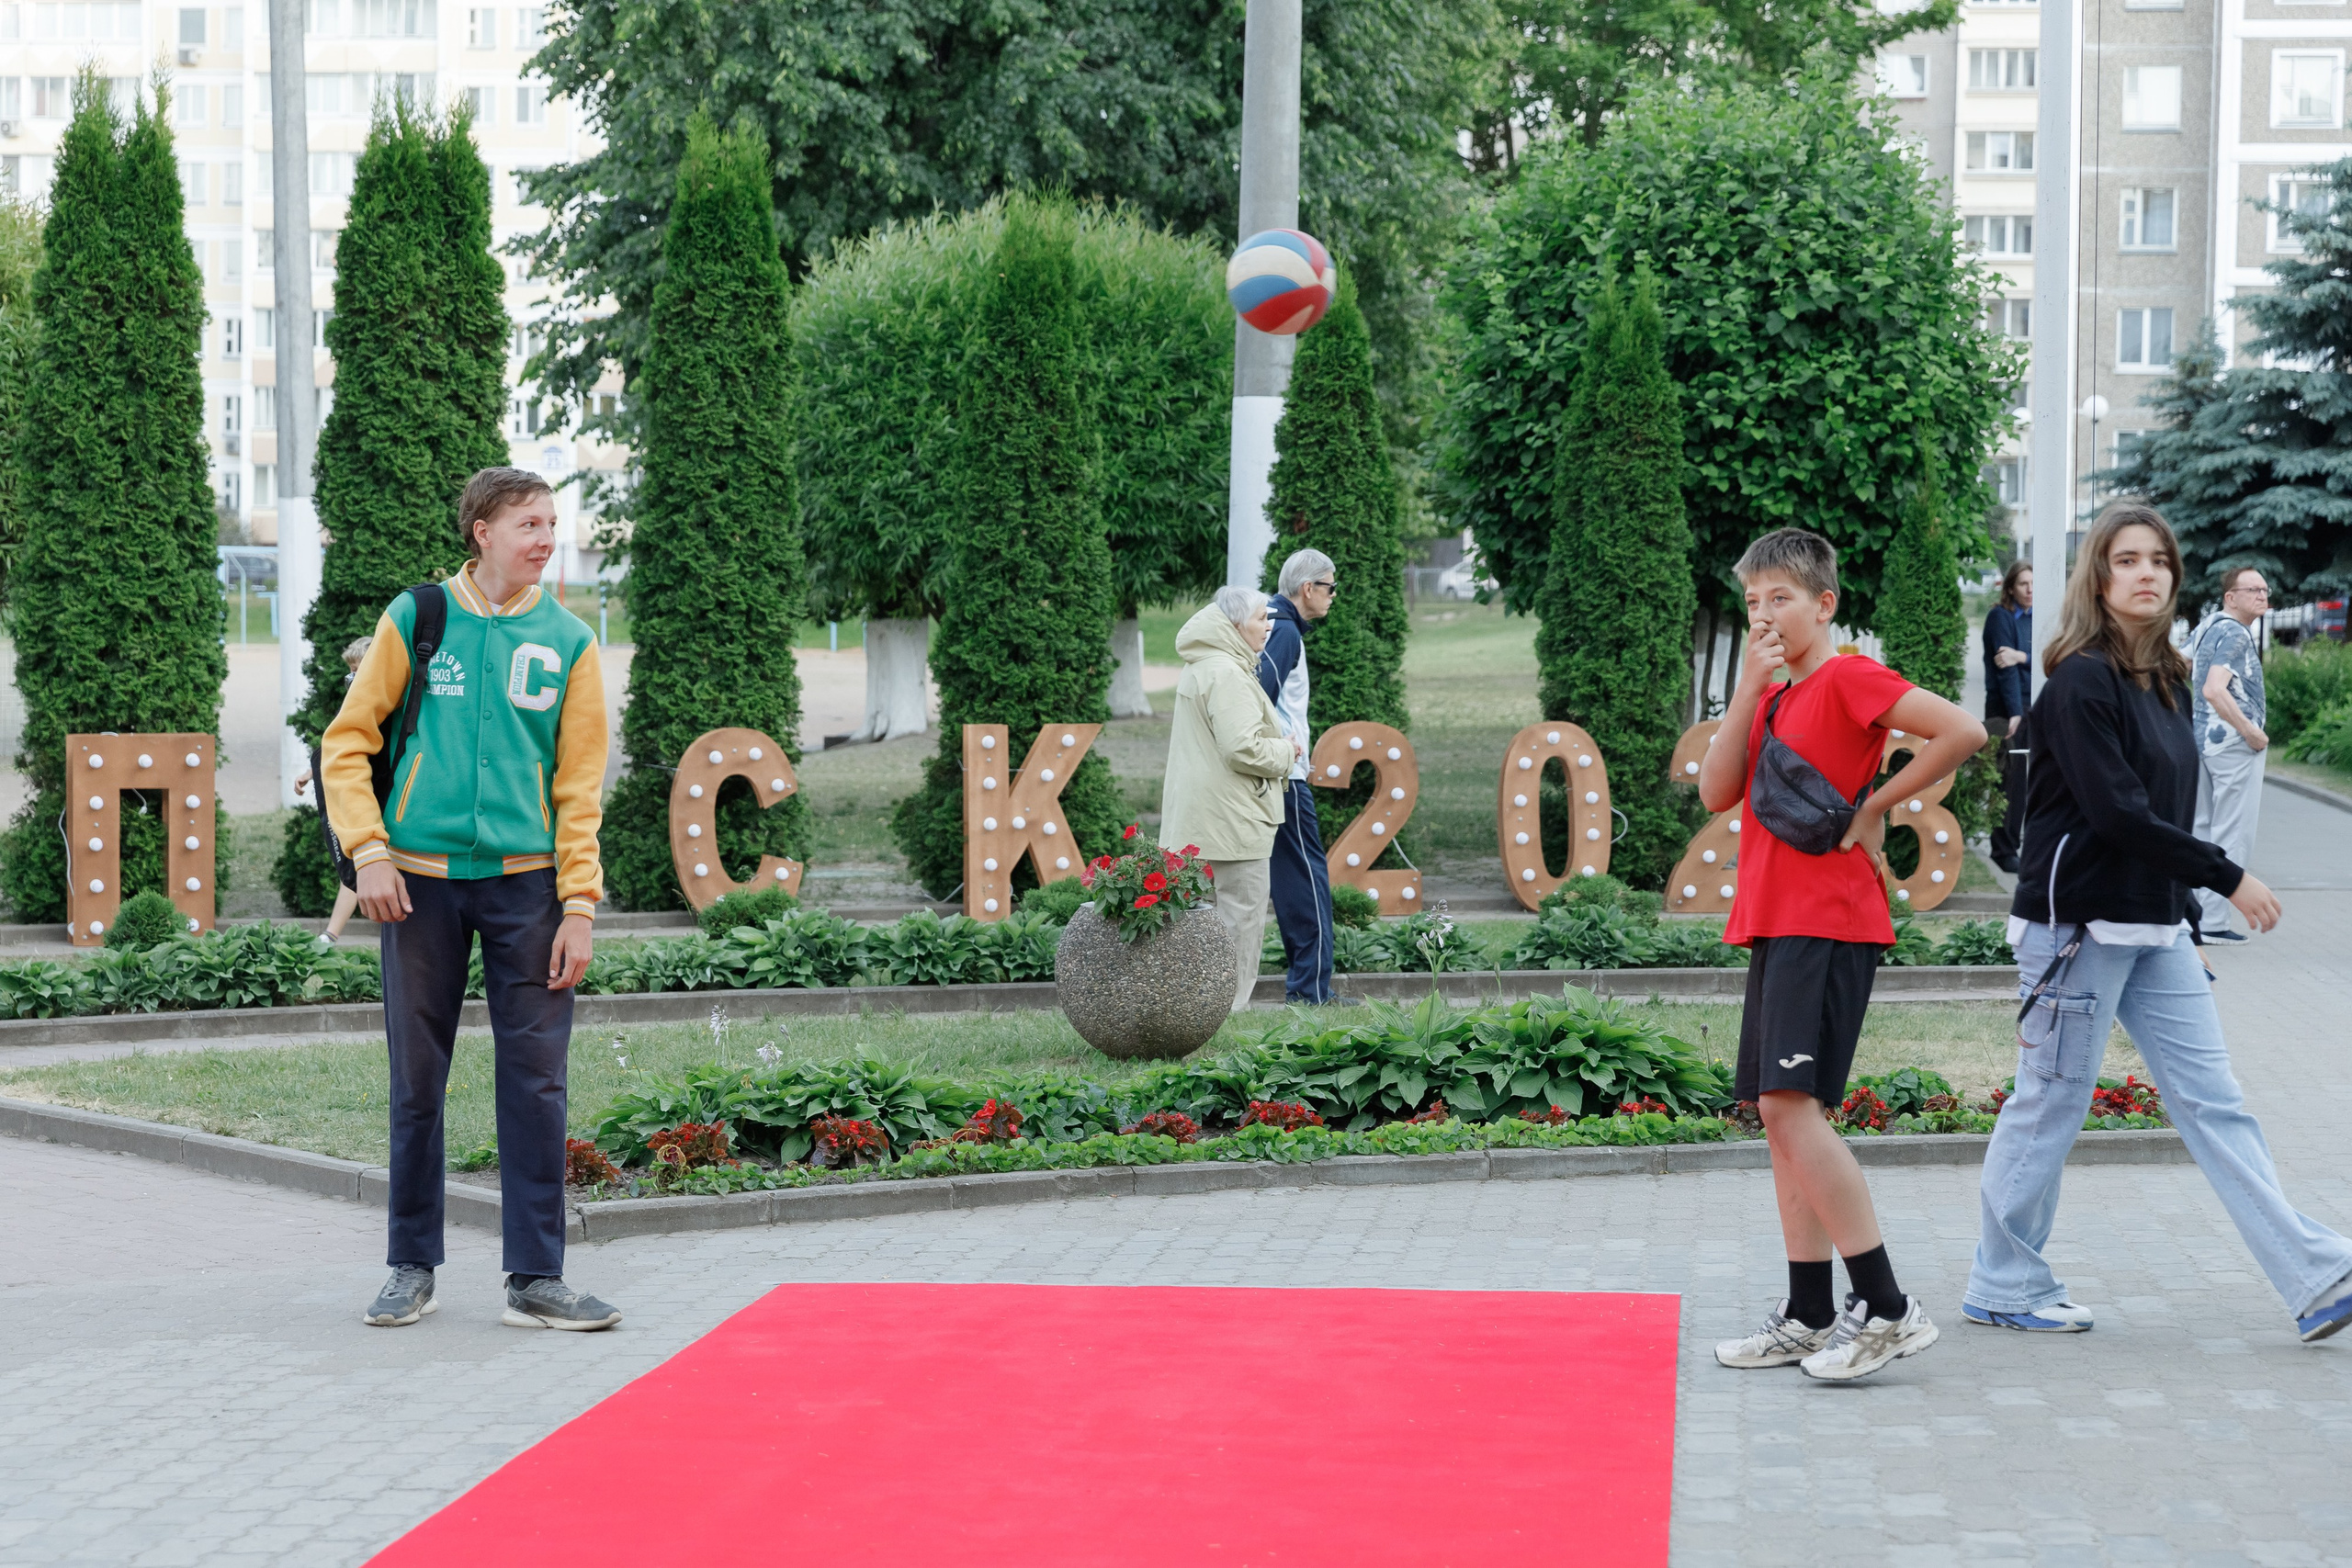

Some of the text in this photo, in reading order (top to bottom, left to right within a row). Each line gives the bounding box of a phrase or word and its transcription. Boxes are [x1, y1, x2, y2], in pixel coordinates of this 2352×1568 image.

[430, 668, 451, 682] 1903
[508, 642, 561, 712] C
[512, 655, 526, 695] CHAMPION
[327, 819, 342, 863] WISSGEAR
